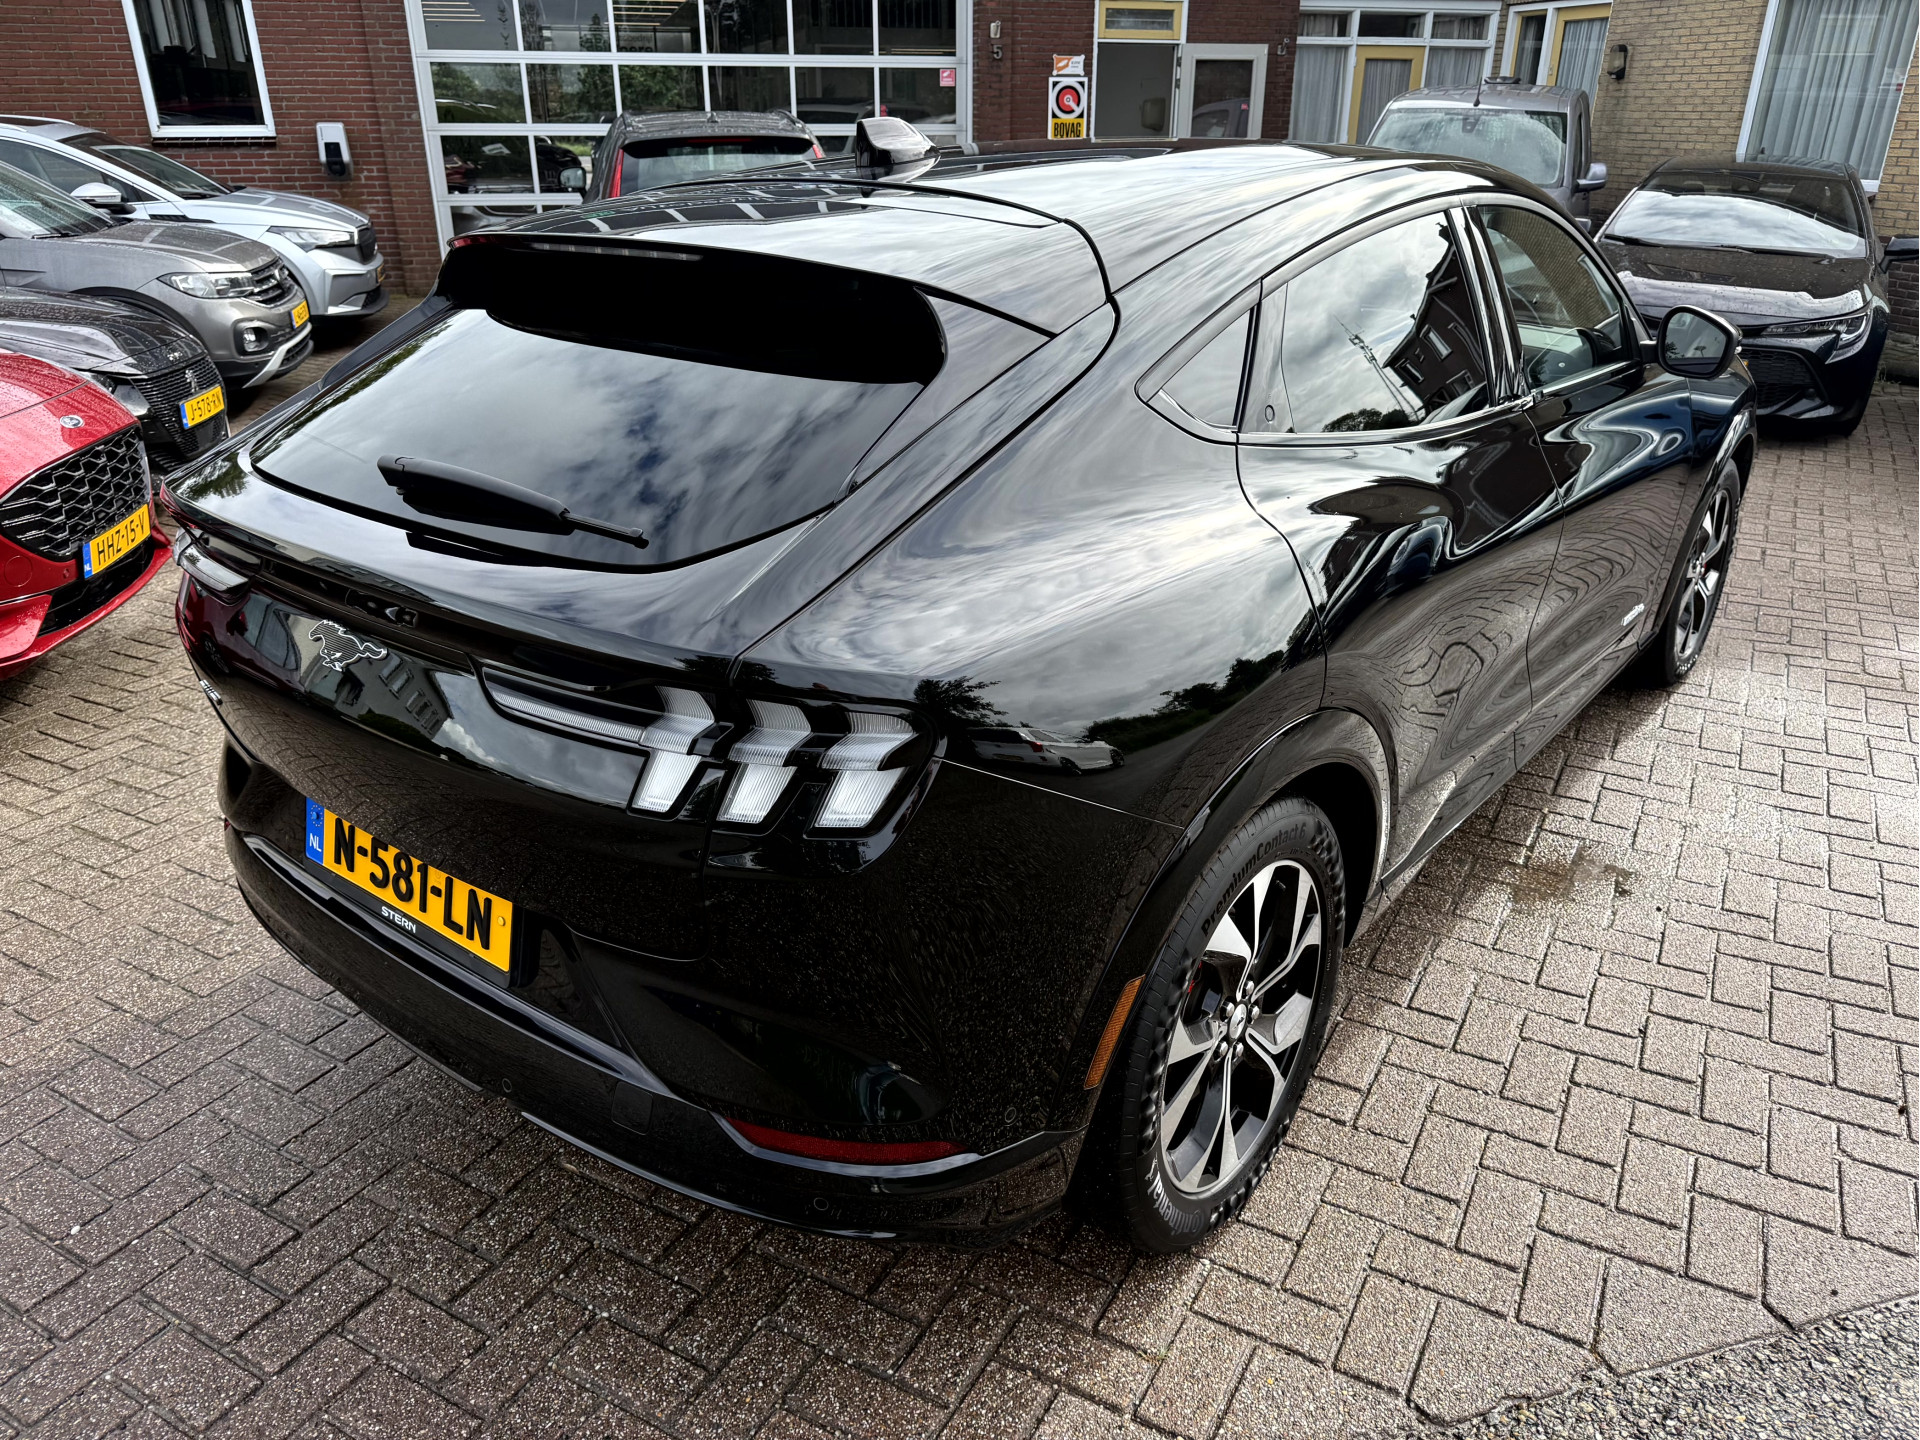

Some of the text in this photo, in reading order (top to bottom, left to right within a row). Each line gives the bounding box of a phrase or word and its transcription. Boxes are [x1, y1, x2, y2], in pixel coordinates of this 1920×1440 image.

[993, 44, 1003, 60] 5
[1053, 122, 1082, 138] BOVAG
[96, 511, 145, 566] HHZ-15-V
[309, 832, 322, 852] NL
[333, 817, 493, 951] N-581-LN
[1200, 823, 1299, 937] PremiumContact
[1299, 821, 1308, 839] 6
[380, 905, 417, 934] STERN
